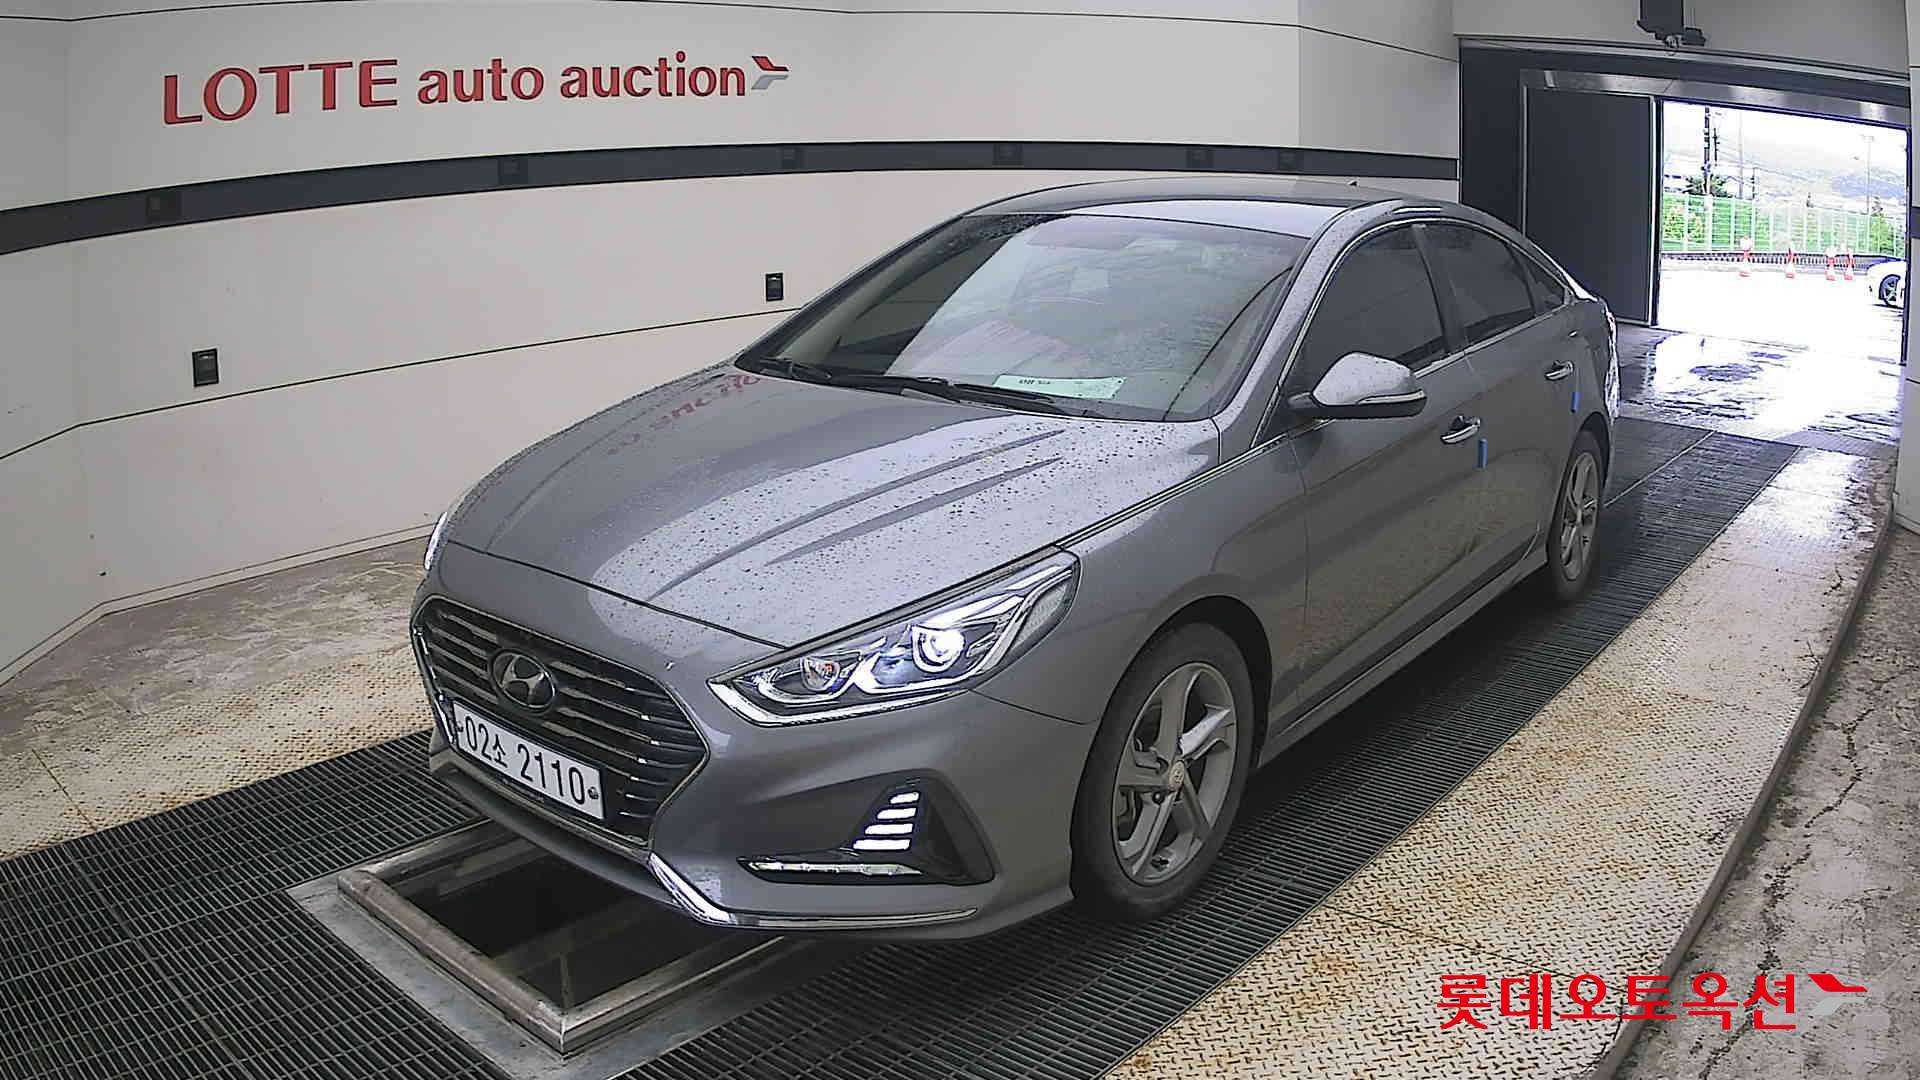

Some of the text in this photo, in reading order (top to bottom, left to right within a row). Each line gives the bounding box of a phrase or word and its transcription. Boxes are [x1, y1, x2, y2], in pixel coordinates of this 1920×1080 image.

[163, 51, 746, 125] LOTTE auto auction
[465, 716, 585, 805] 02소 2110
